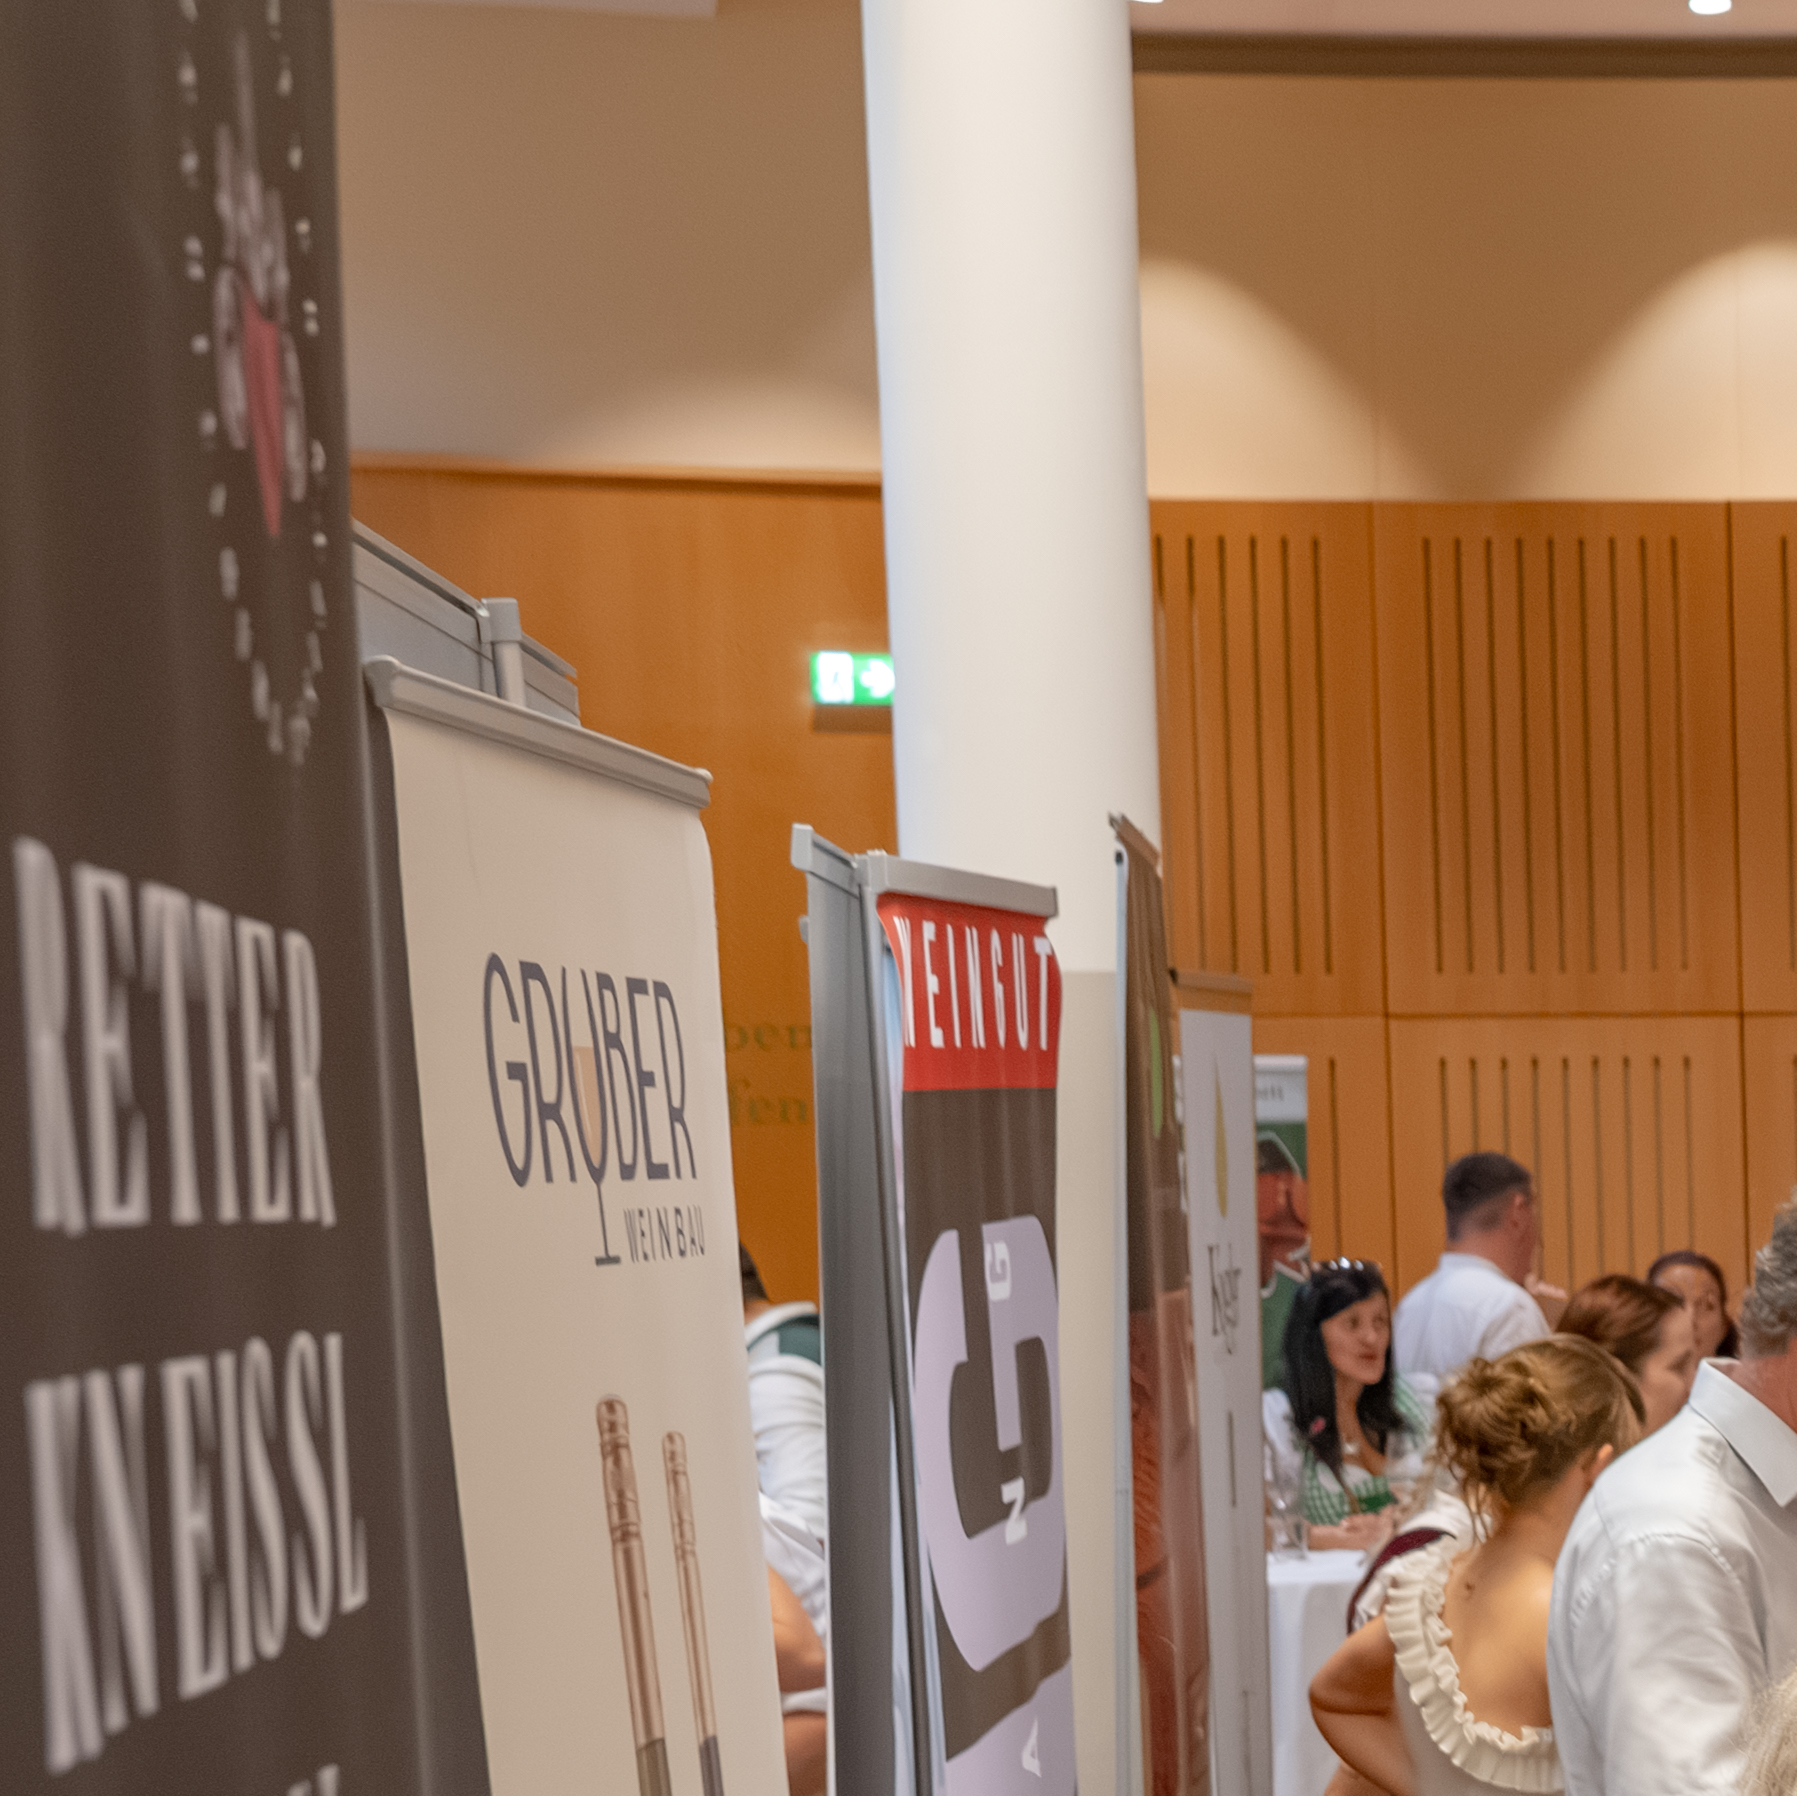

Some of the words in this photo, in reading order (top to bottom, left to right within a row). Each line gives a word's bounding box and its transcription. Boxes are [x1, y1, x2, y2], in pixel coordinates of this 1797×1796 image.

[13, 835, 337, 1237] RETTER
[484, 952, 697, 1188] GRUBER
[893, 916, 1053, 1050] WEINGUT
[624, 1205, 705, 1263] WEINBAU
[25, 1330, 368, 1776] KNEISSL
